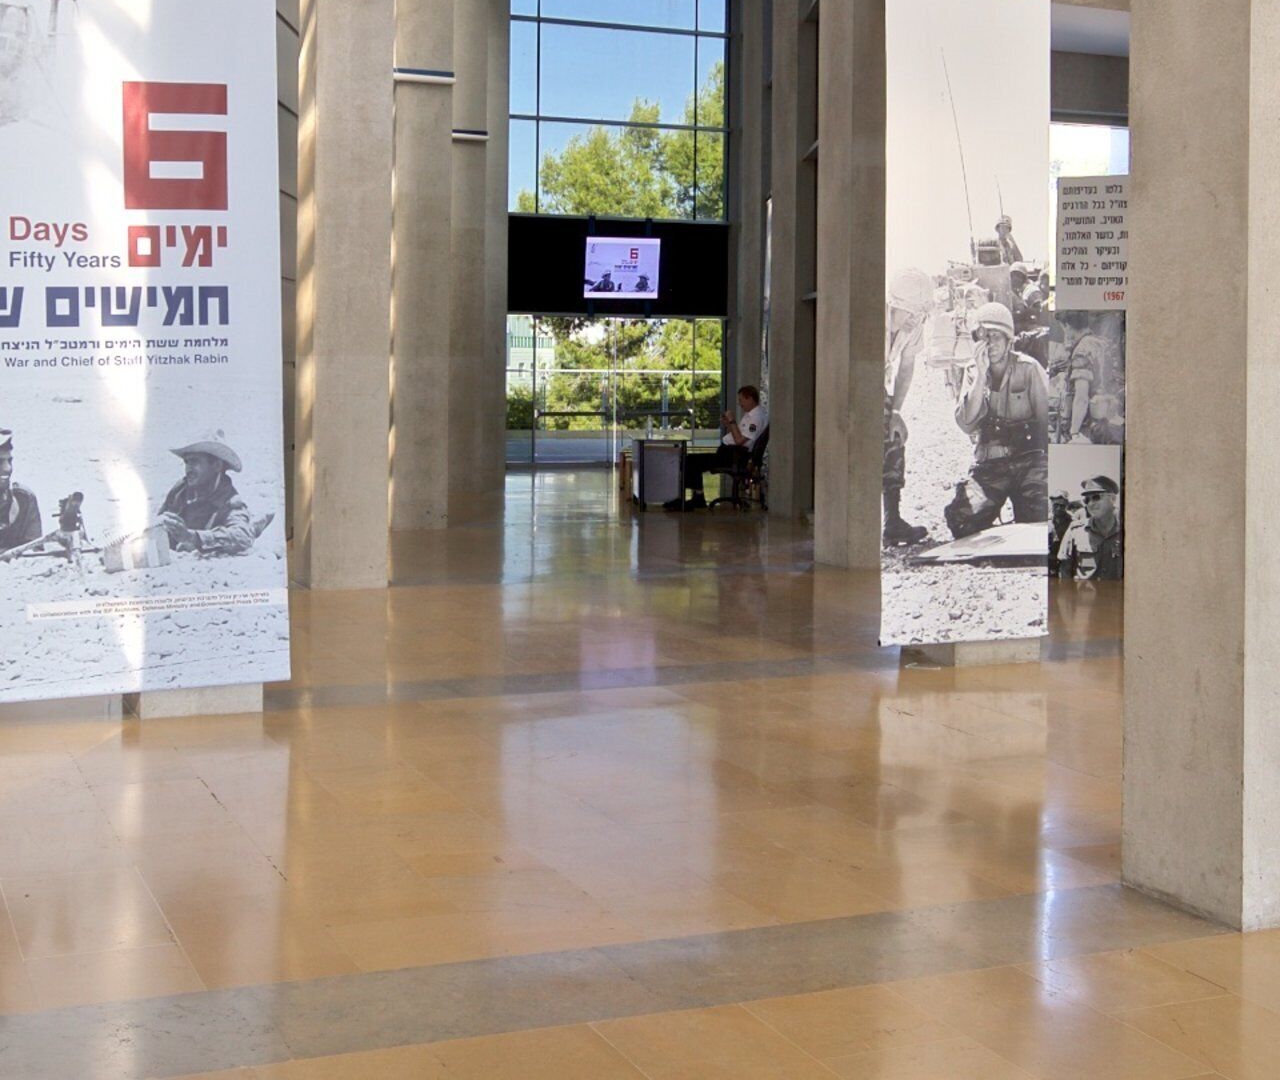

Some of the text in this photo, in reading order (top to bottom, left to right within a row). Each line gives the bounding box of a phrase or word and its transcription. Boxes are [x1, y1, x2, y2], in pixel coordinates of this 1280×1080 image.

[123, 81, 228, 210] 6
[9, 216, 88, 247] Days
[128, 225, 227, 267] ימים
[630, 248, 639, 259] 6
[9, 251, 121, 272] Fifty Years
[45, 286, 229, 327] חמישים
[105, 339, 141, 349] הימים
[146, 339, 179, 348] ששת
[184, 337, 228, 348] מלחמת
[4, 357, 29, 368] War
[33, 356, 57, 367] and
[61, 356, 94, 367] Chief
[98, 355, 110, 366] of
[114, 355, 143, 365] Staff
[146, 354, 190, 366] Yitzhak
[194, 353, 228, 364] Rabin
